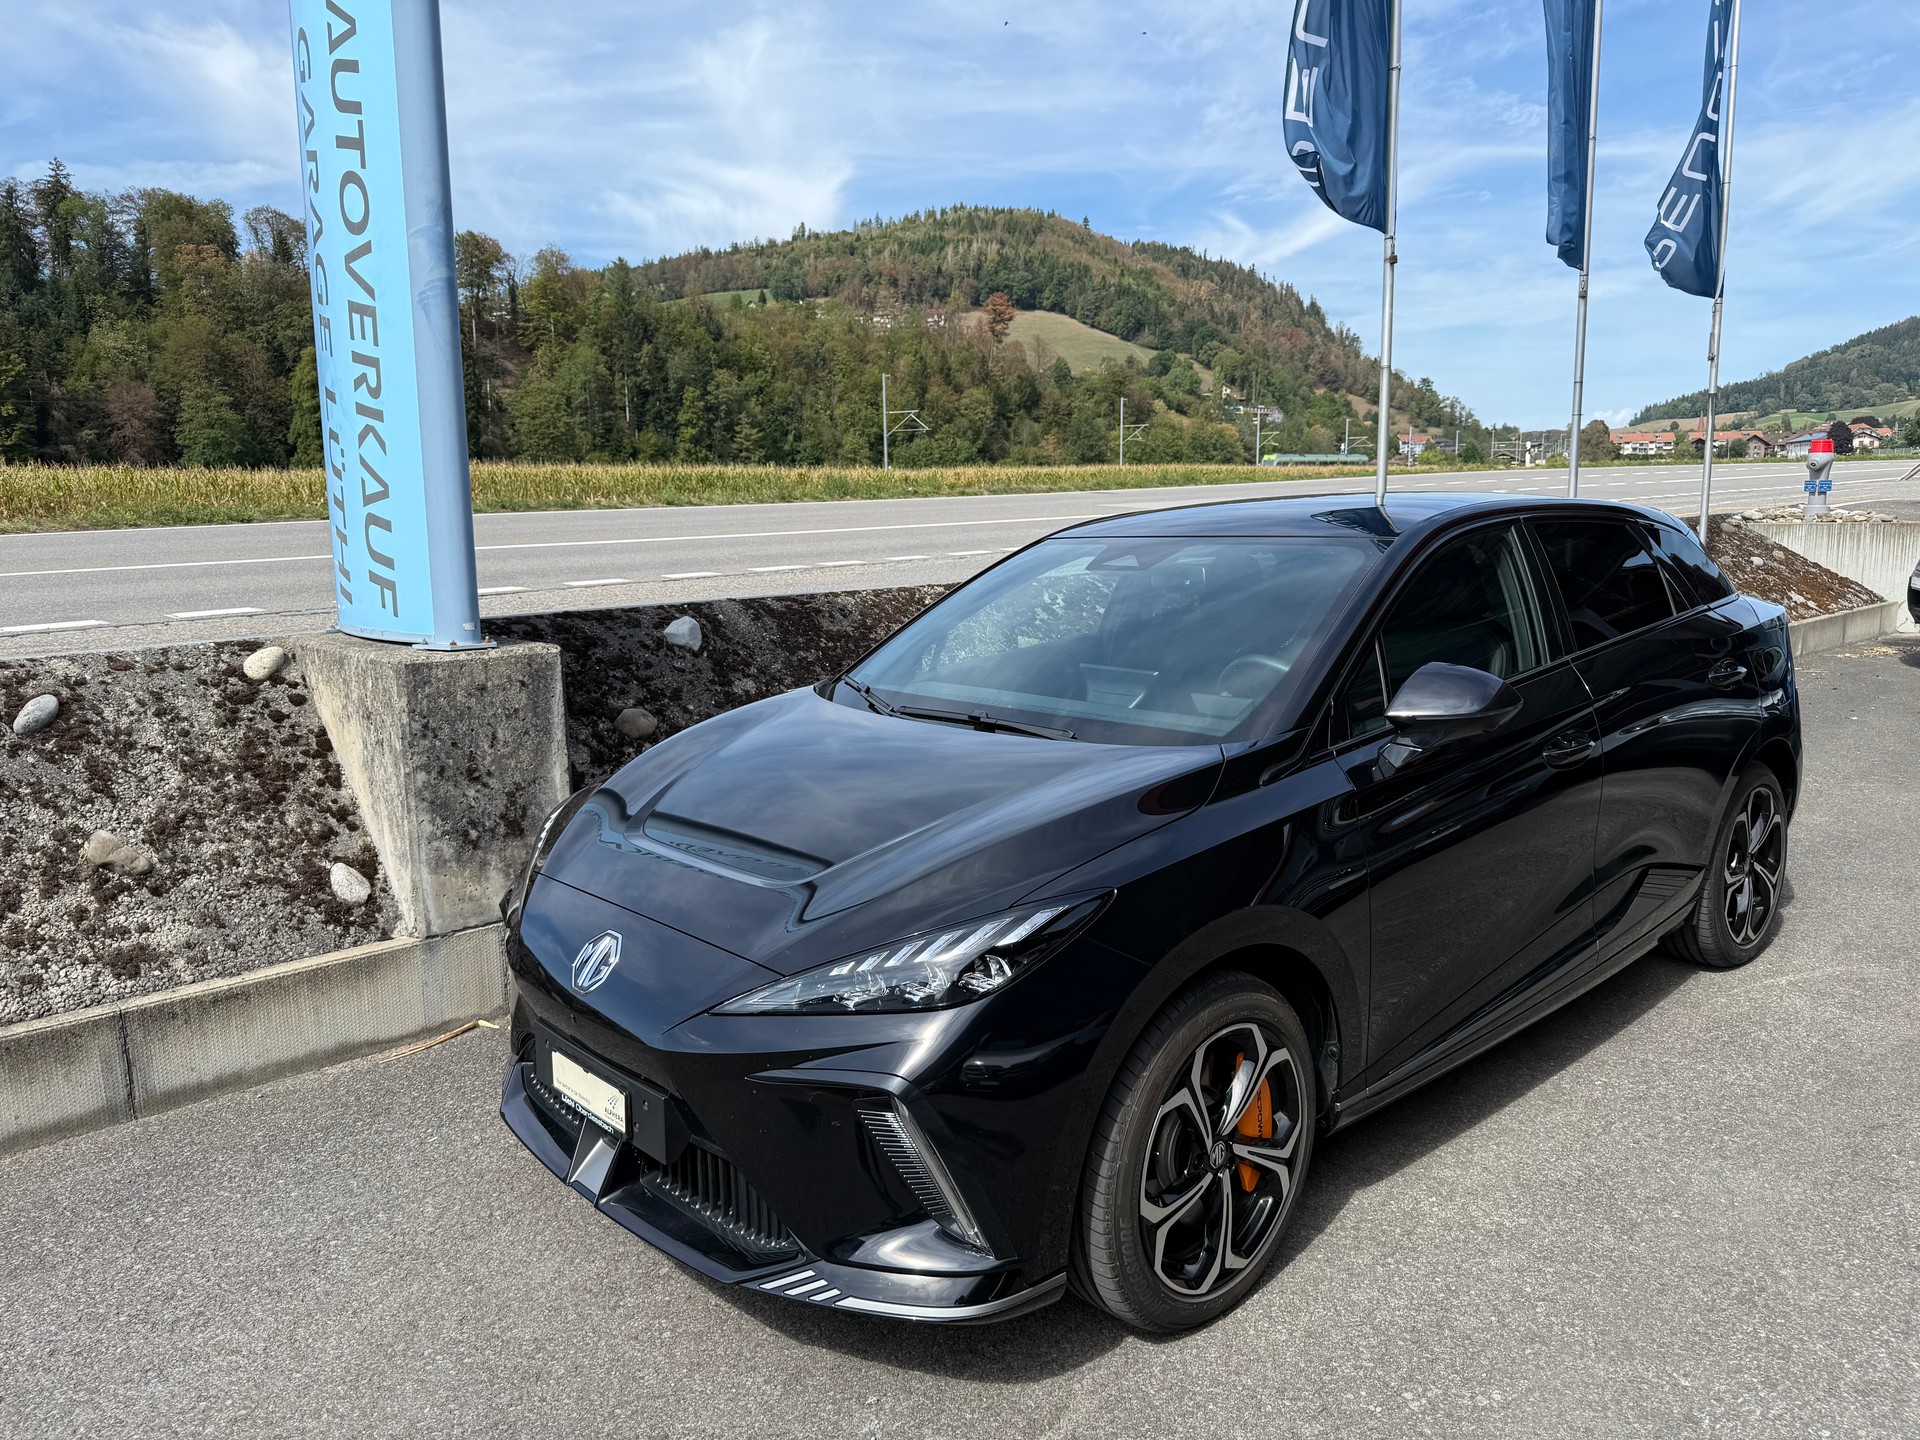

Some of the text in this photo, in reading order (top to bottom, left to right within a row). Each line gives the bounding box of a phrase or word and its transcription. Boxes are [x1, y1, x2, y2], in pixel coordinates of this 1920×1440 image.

[297, 26, 353, 606] GARAGE LÜTHI
[326, 0, 399, 618] AUTOVERKAUF
[572, 934, 620, 989] MG
[1211, 1143, 1225, 1166] MG
